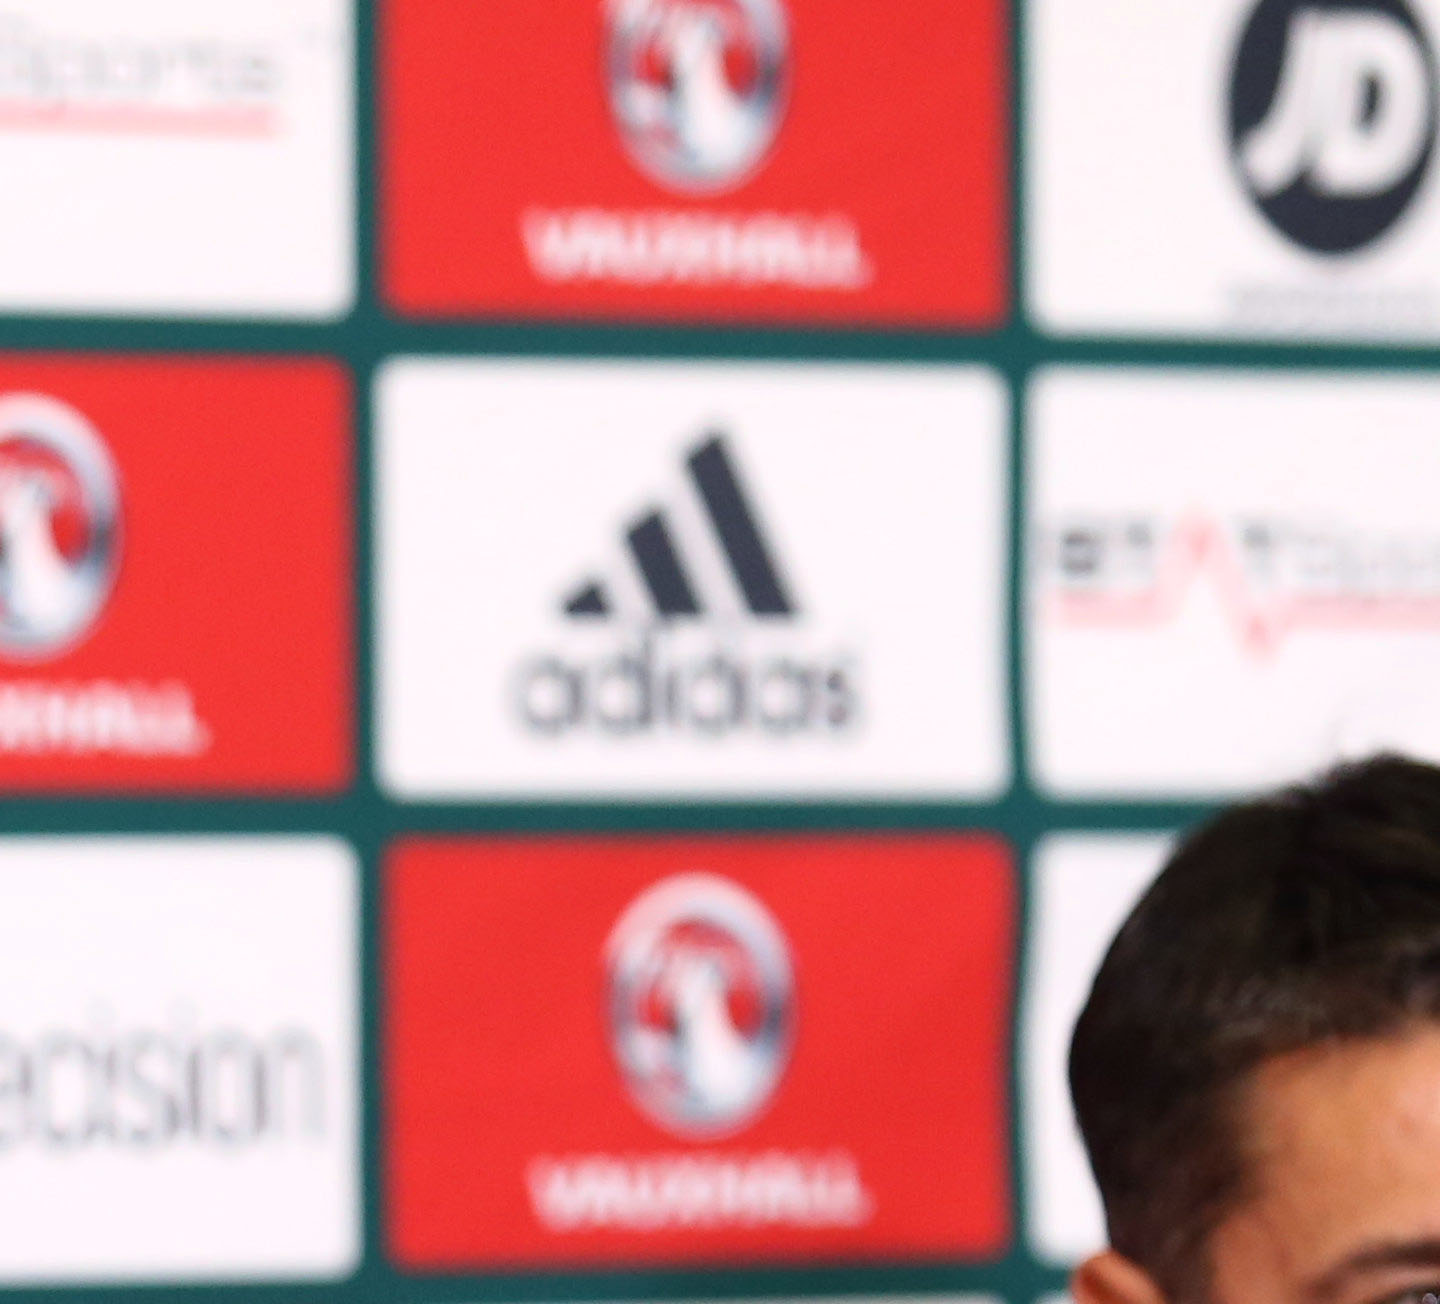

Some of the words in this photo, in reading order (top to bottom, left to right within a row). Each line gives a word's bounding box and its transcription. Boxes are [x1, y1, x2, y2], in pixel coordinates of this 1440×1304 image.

[523, 210, 872, 292] VAUXHALL
[511, 624, 862, 738] adidas
[524, 1150, 875, 1232] VAUXHALL
